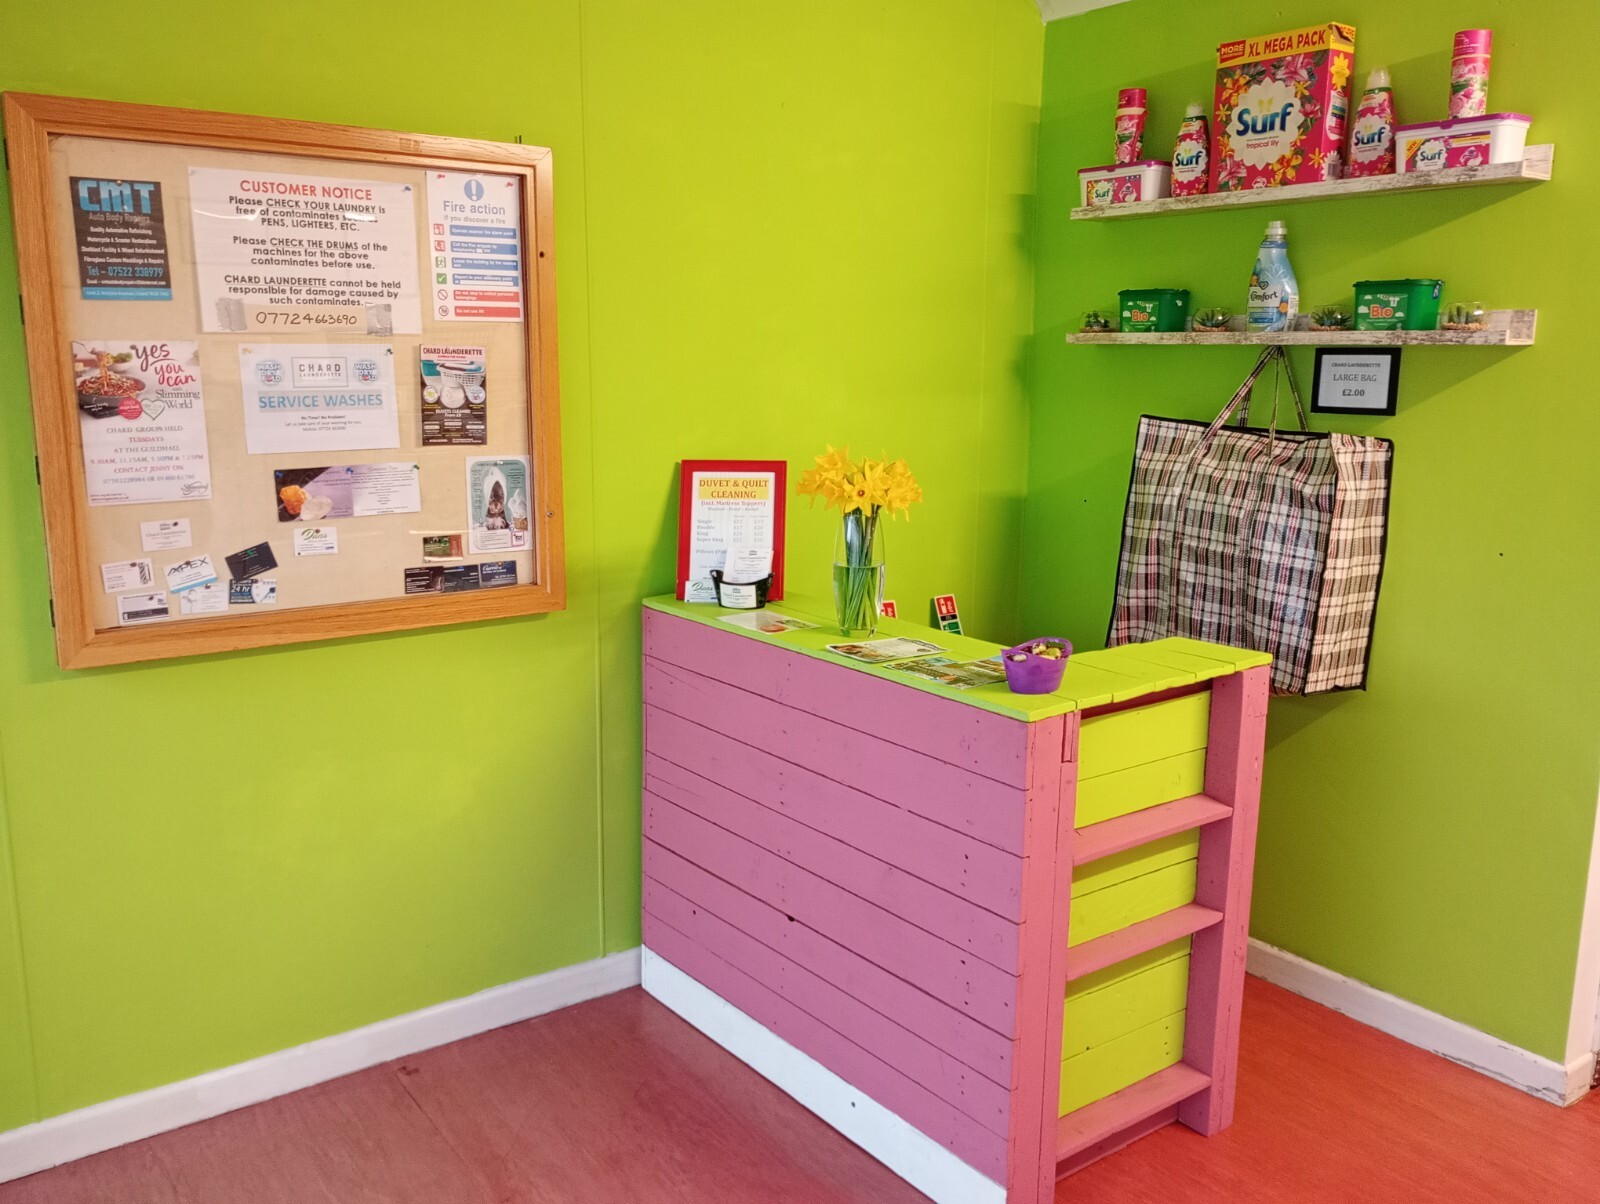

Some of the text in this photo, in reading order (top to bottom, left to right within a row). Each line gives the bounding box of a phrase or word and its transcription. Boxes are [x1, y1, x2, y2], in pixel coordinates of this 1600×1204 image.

[1222, 44, 1244, 54] MORE
[1248, 30, 1326, 57] XL MEGA PACK
[1236, 103, 1294, 136] Surf
[1355, 127, 1386, 146] Surf
[1246, 141, 1269, 149] tropical
[1175, 151, 1203, 166] Surf
[1420, 149, 1443, 161] Surf
[240, 180, 372, 200] CUSTOMER NOTICE
[1095, 188, 1110, 198] Surf
[78, 180, 155, 214] CMT
[229, 196, 262, 206] Please
[266, 198, 301, 208] CHECK
[304, 201, 330, 210] YOUR
[333, 203, 375, 213] LAUNDRY
[443, 200, 505, 215] Fire action
[106, 213, 123, 223] Body
[125, 214, 150, 223] Repairs
[236, 206, 255, 215] free
[260, 208, 269, 216] of
[273, 209, 339, 220] contaminates
[261, 218, 360, 231] PENS, LIGHTERS, ETC.
[463, 216, 488, 224] discover
[233, 236, 388, 252] Please CHECK THE DRUMS of the
[253, 247, 369, 260] machines for the above
[251, 257, 319, 268] contaminates
[322, 260, 353, 269] before
[87, 266, 163, 277] Tel 07522 338979
[224, 275, 401, 289] CHARD LAUNDERETTE cannot be held
[228, 286, 399, 299] responsible for damage caused by
[1251, 291, 1278, 302] Comfort
[269, 296, 364, 307] such contaminates.
[1132, 310, 1148, 321] Bio
[1370, 304, 1394, 318] Bio
[130, 344, 170, 372] yes
[154, 363, 184, 385] you
[299, 364, 341, 372] CHARD
[166, 374, 196, 386] can
[156, 390, 200, 400] Slimming
[259, 394, 383, 408] SERVICE WASHES
[164, 400, 193, 409] World
